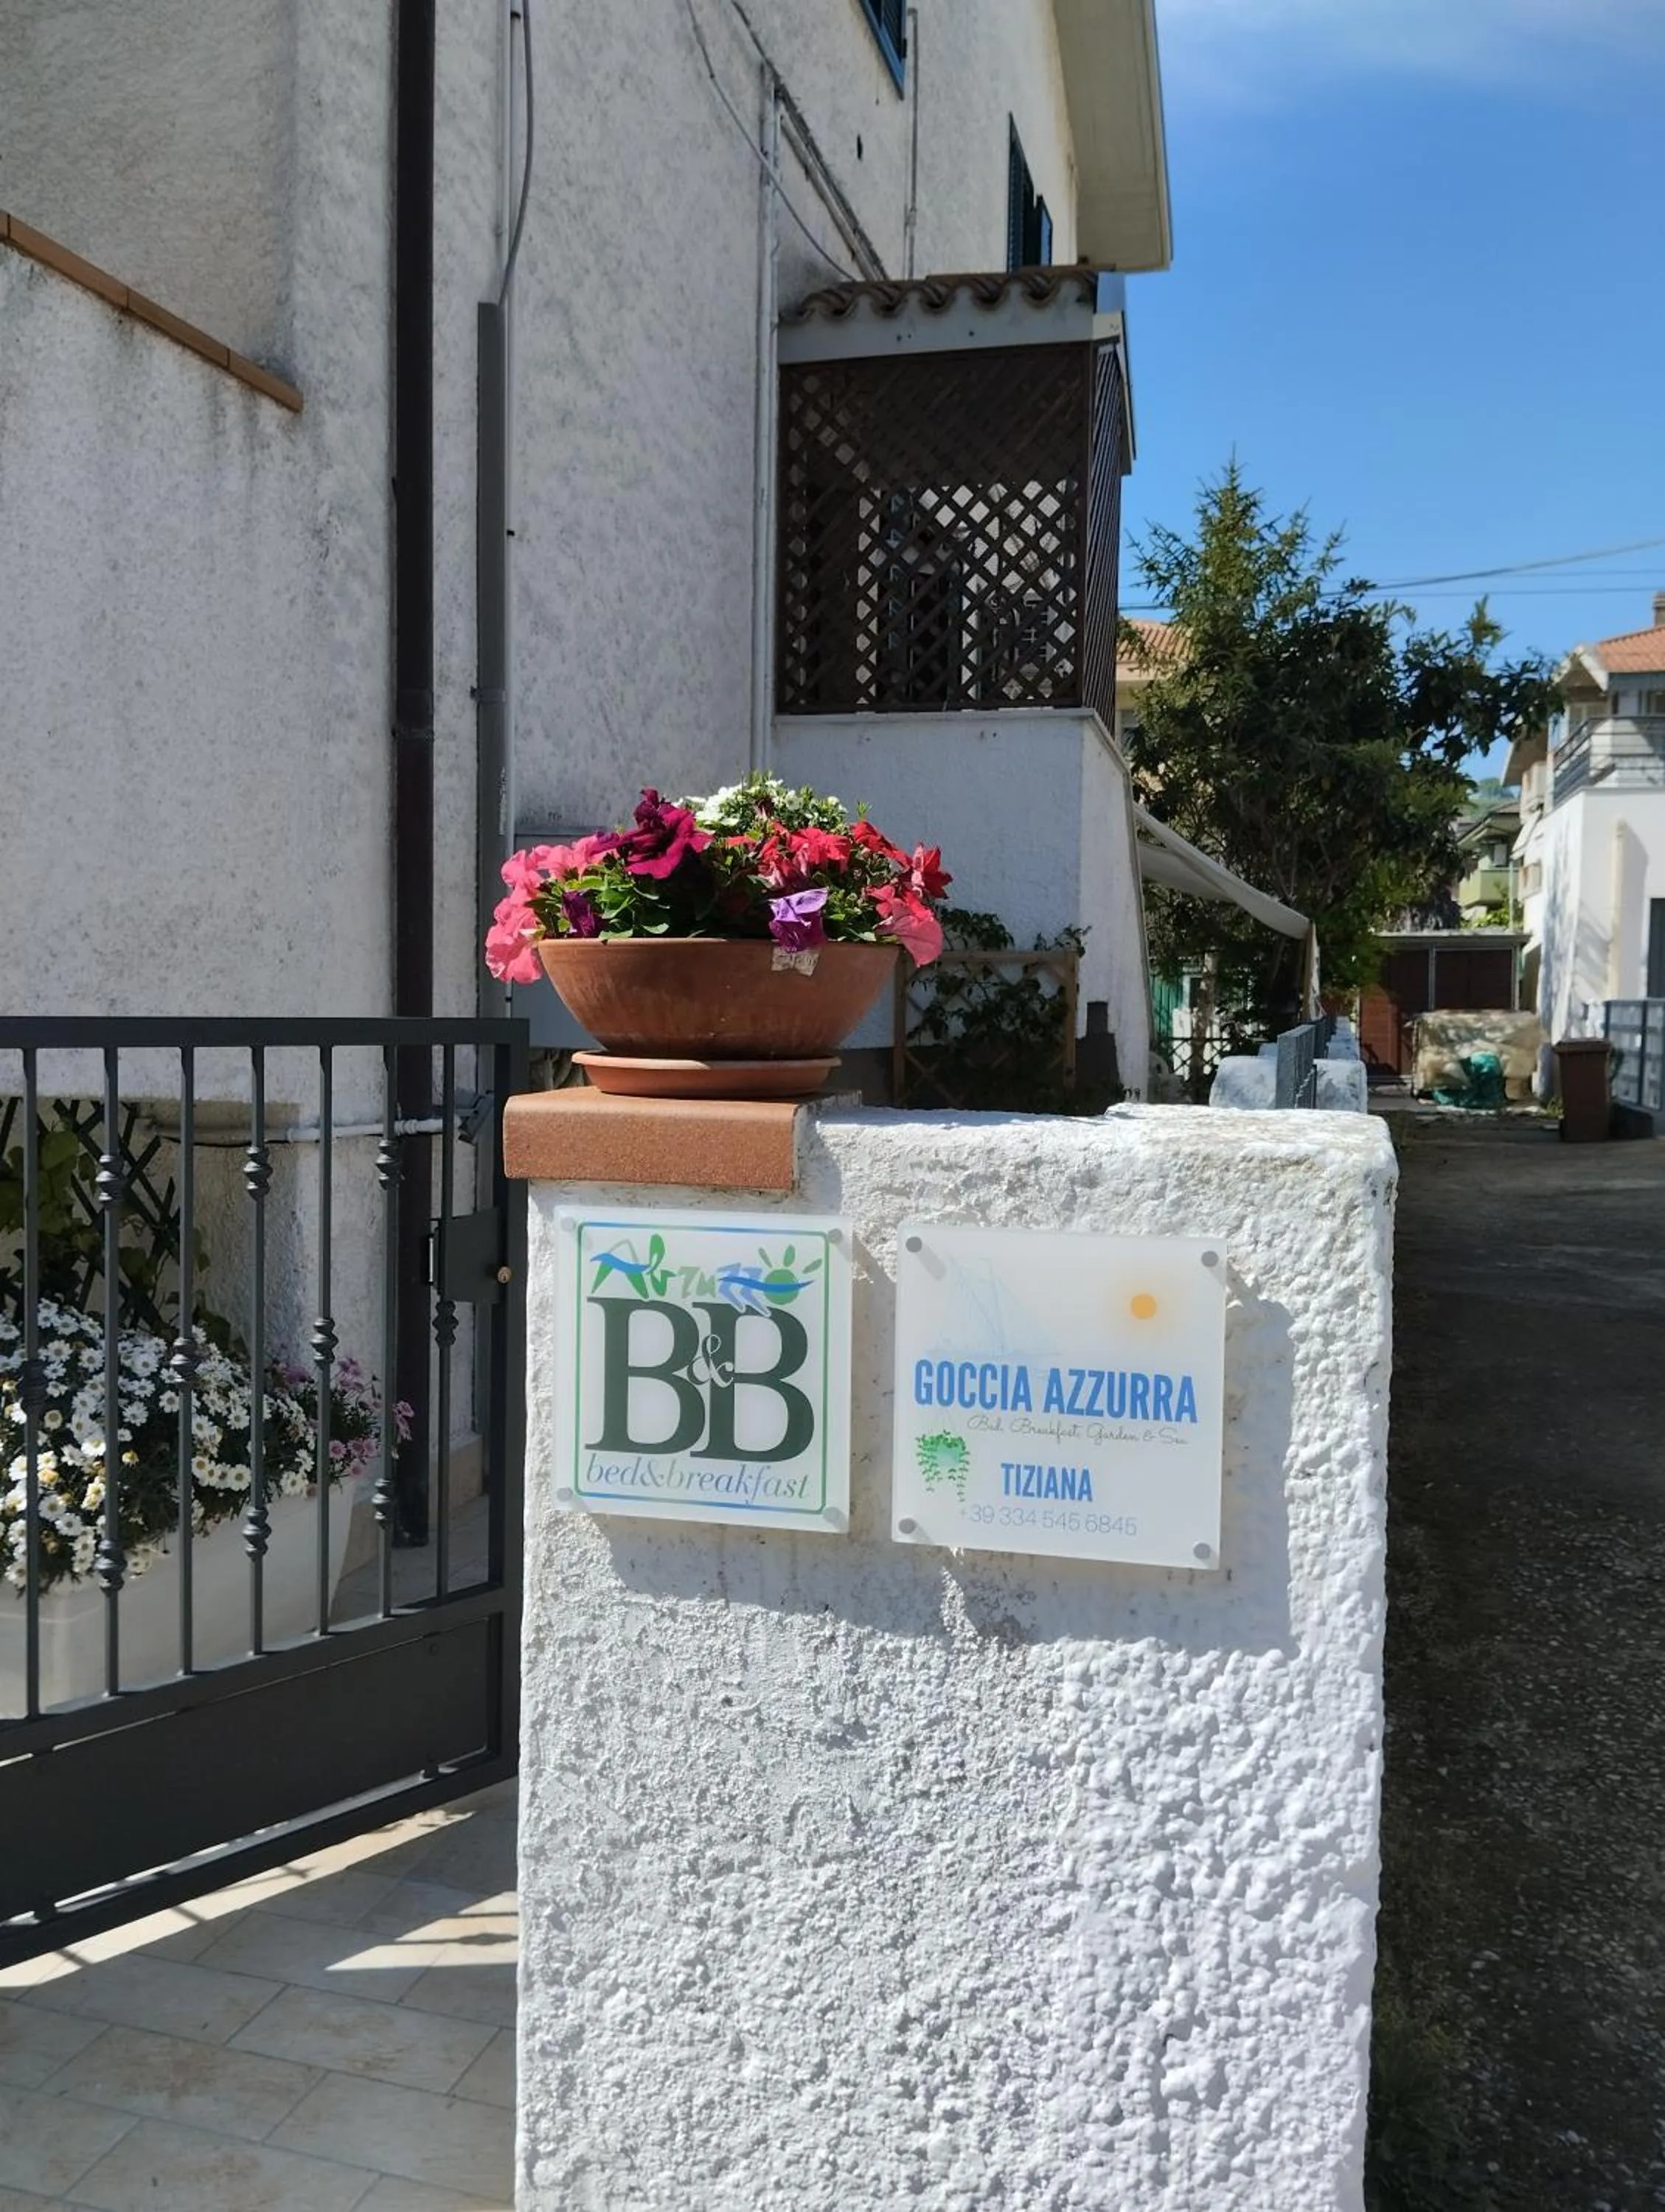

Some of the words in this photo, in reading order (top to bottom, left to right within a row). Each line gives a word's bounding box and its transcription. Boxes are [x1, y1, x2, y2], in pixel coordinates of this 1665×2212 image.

[585, 1296, 815, 1462] B&B
[914, 1359, 1032, 1412] GOCCIA
[1043, 1367, 1198, 1424] AZZURRA
[1143, 1428, 1156, 1442] &
[586, 1453, 809, 1501] bed&breakfast
[1001, 1462, 1094, 1502] TIZIANA
[959, 1503, 995, 1524] +39
[999, 1506, 1037, 1526] 334
[1085, 1513, 1137, 1537] 6845
